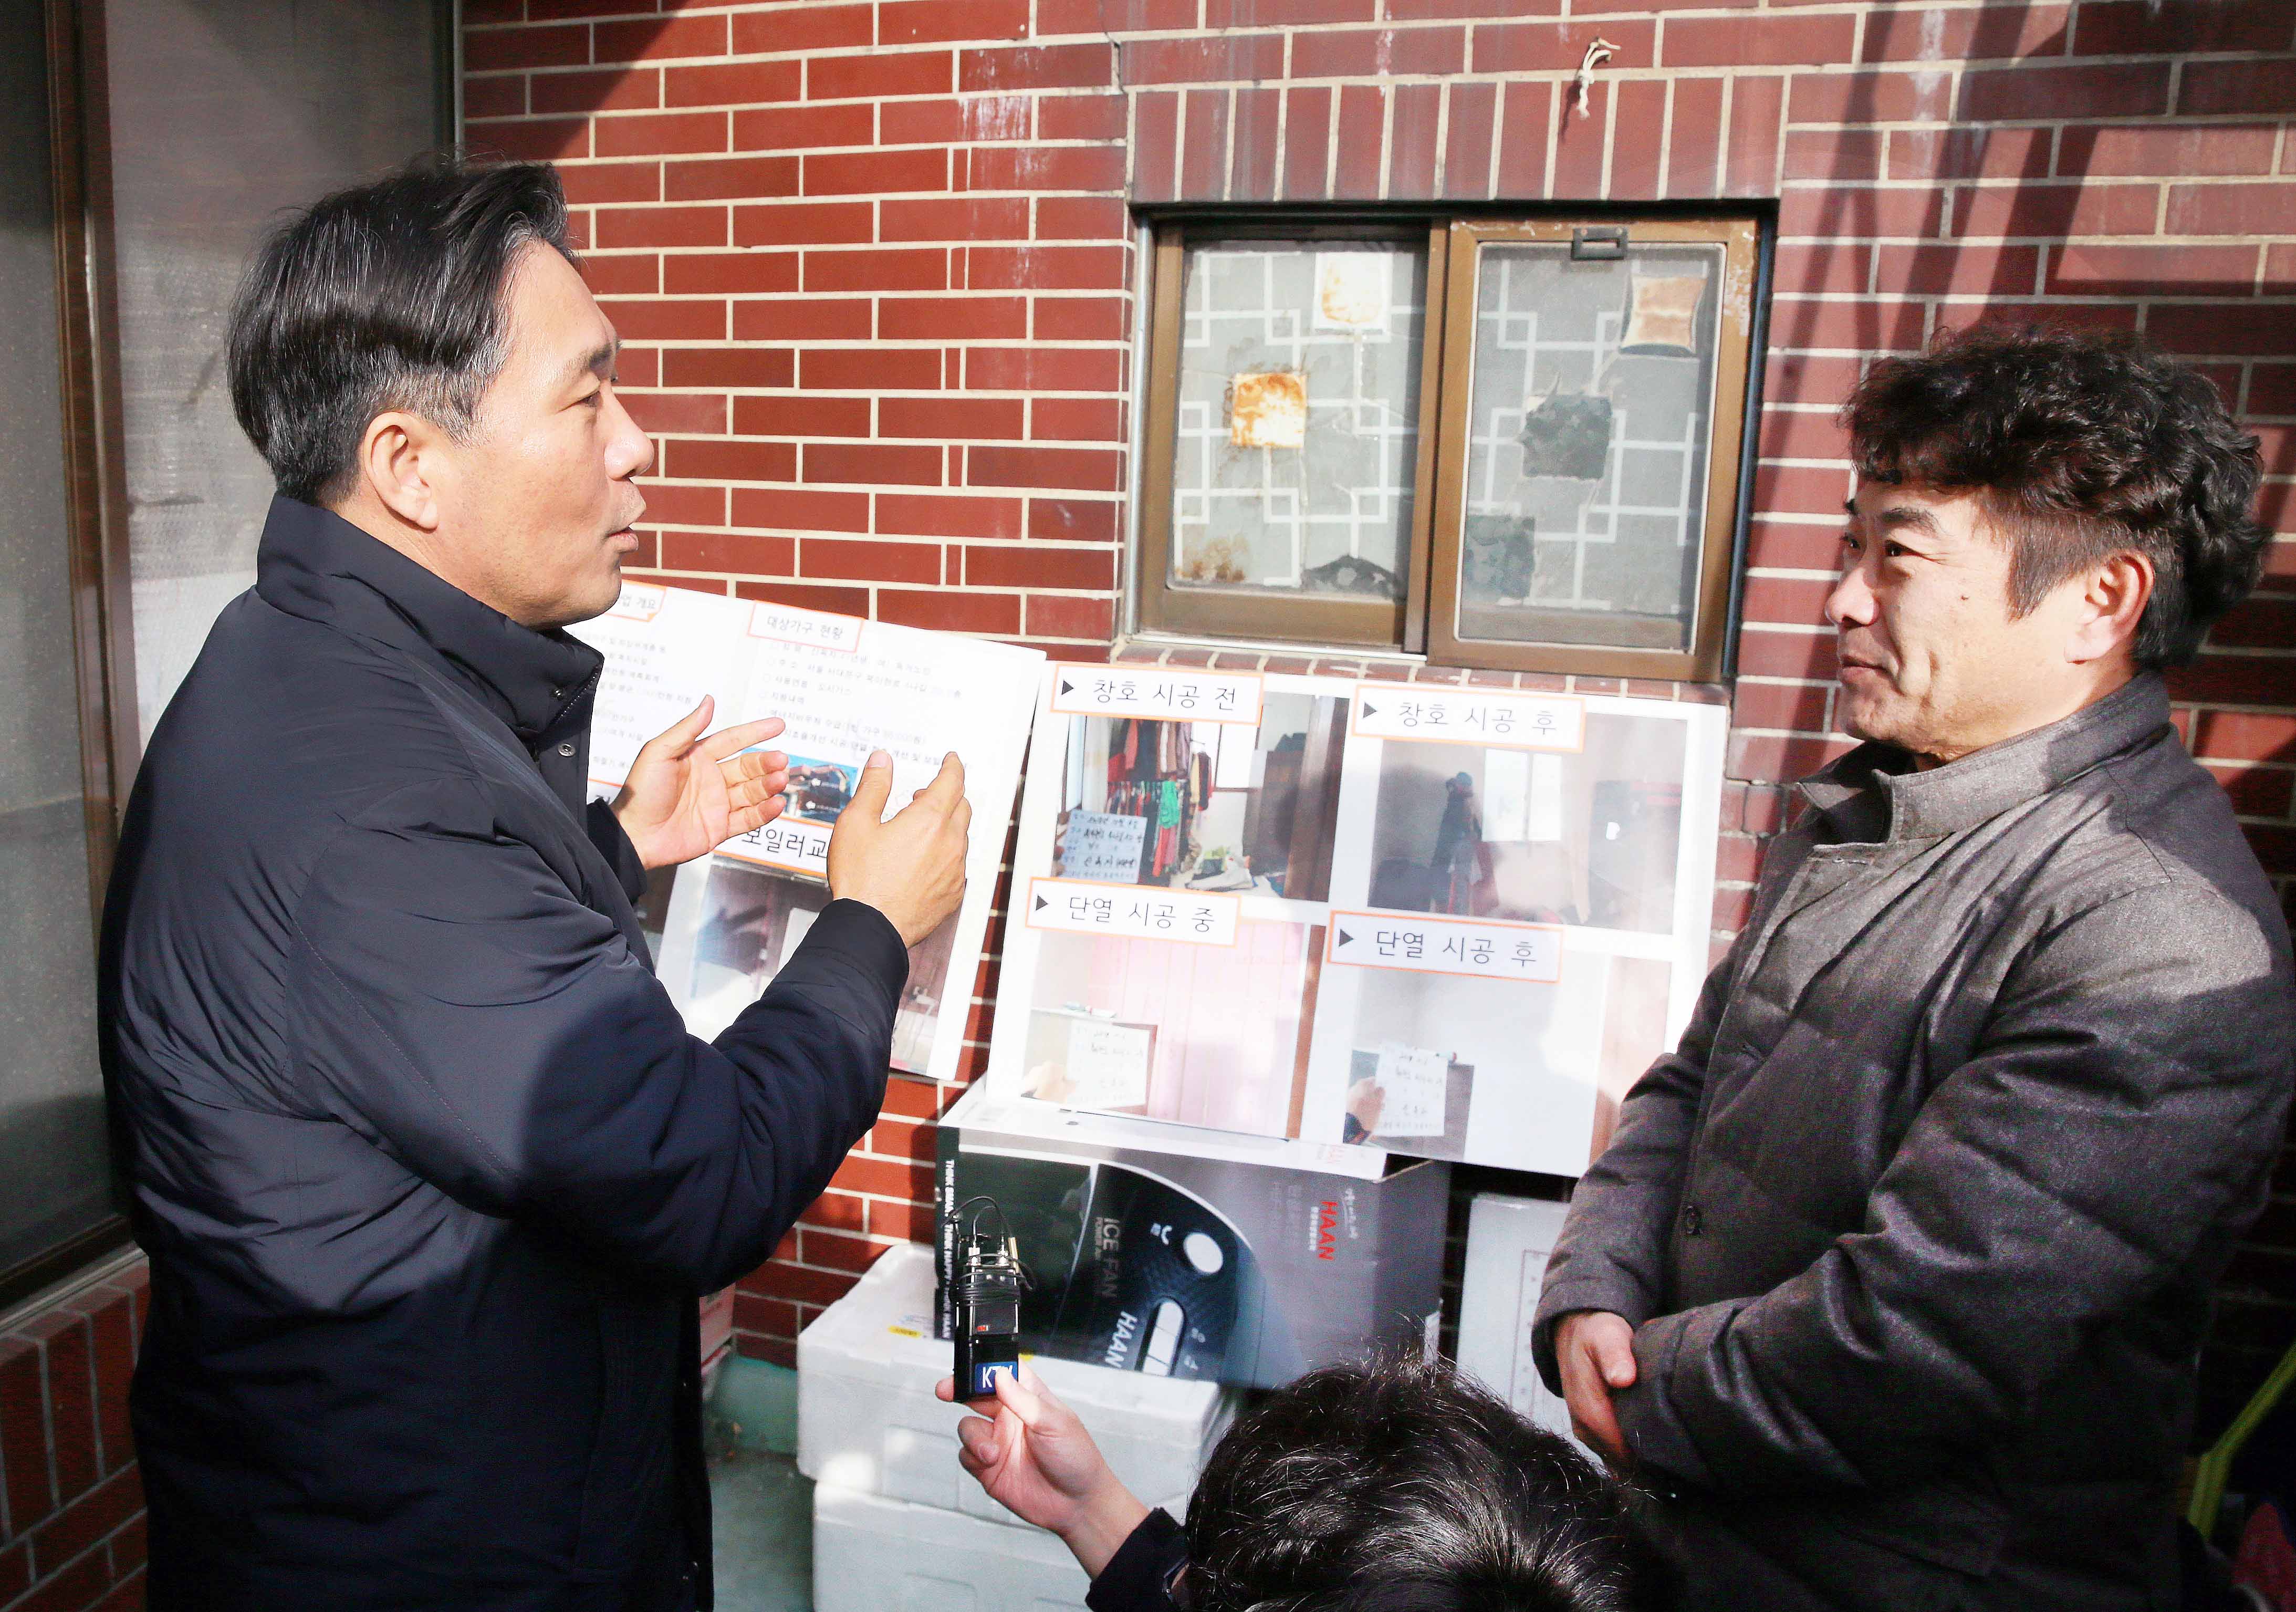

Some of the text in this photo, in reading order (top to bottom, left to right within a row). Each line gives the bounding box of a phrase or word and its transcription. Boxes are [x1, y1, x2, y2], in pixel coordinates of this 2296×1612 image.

[767, 616, 844, 640] 대상가구 현황
[1094, 680, 1235, 711] 창호 시공 전
[1400, 703, 1556, 735] 창호 시공 후
[1070, 897, 1214, 932] 단열 시공 중
[1376, 931, 1536, 967] 단열 시공 후
[1318, 1202, 1339, 1261] HAAN
[1102, 1218, 1120, 1297] ICE FAN
[1105, 1311, 1138, 1368] HAAN
